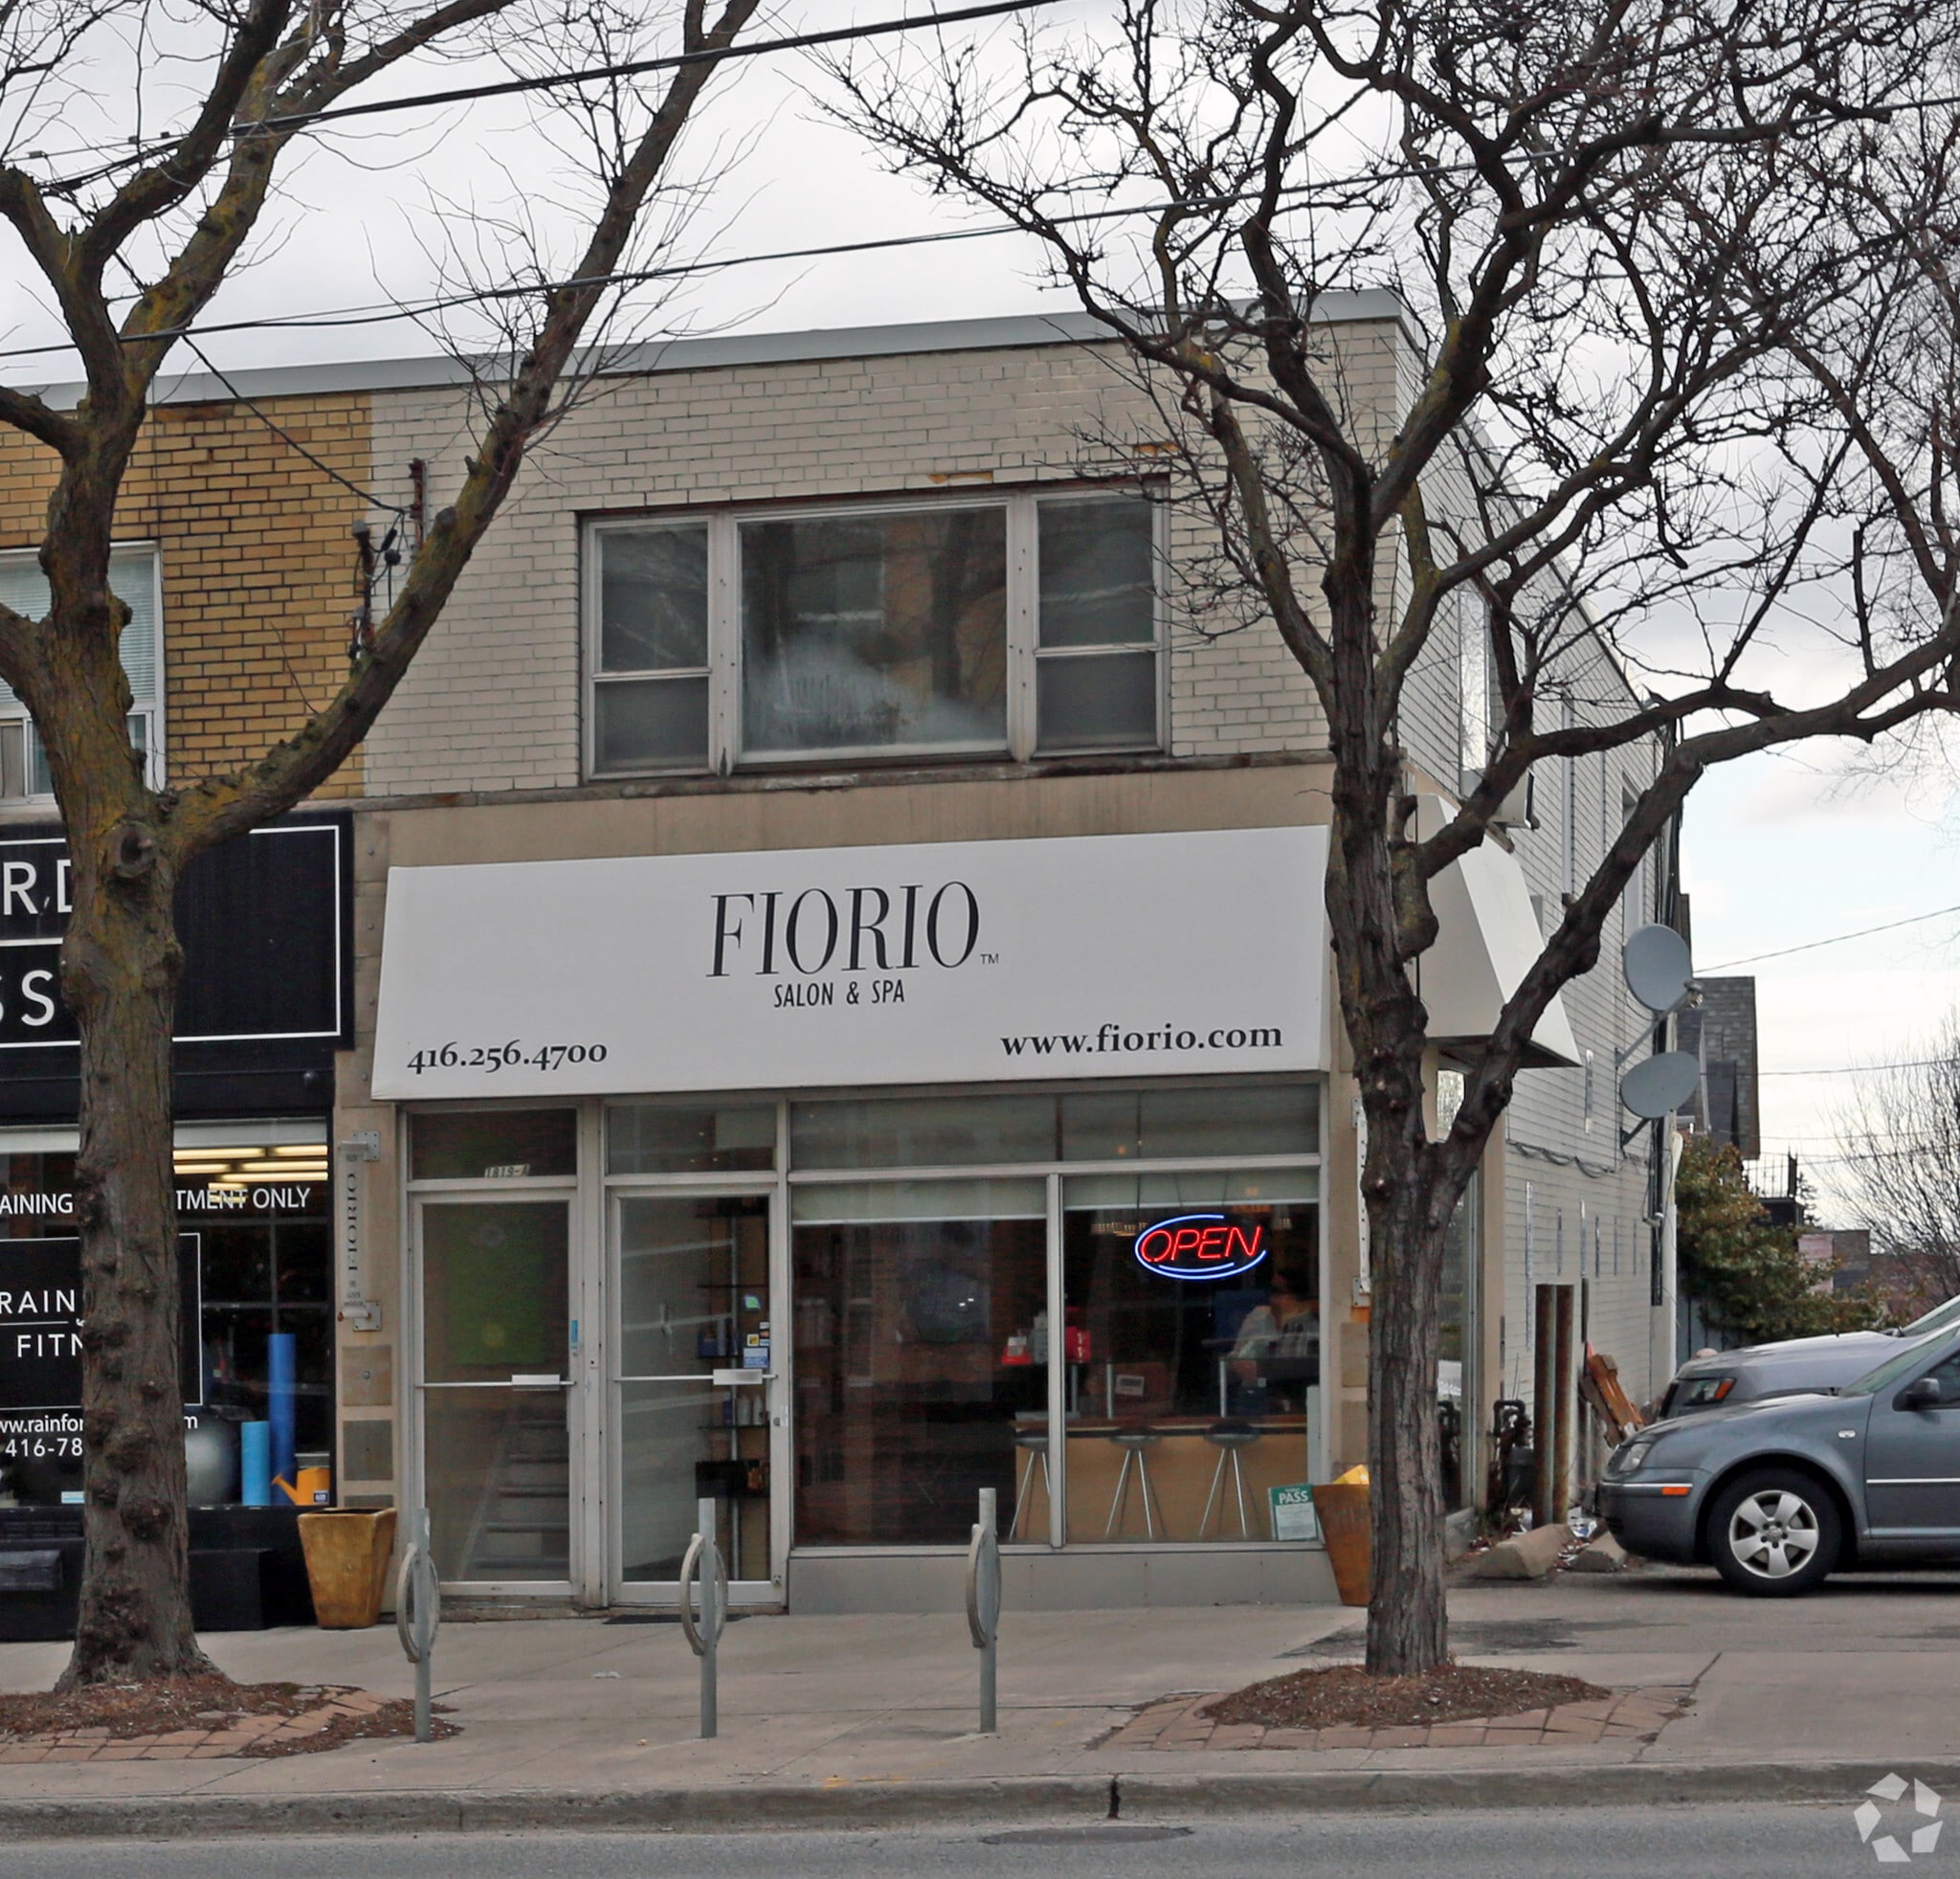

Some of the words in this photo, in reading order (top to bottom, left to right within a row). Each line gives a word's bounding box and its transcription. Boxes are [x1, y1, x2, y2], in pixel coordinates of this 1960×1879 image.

[3, 859, 73, 916] R
[705, 881, 980, 978] FIORIO
[773, 982, 834, 1008] SALON
[846, 981, 859, 1005] &
[872, 979, 904, 1003] SPA
[407, 1039, 608, 1075] 416.256.4700
[1000, 1022, 1283, 1057] www.fiorio.com
[0, 1193, 74, 1215] AINING
[252, 1187, 311, 1209] ONLY
[1140, 1225, 1263, 1263] OPEN
[1279, 1490, 1309, 1505] PASS
